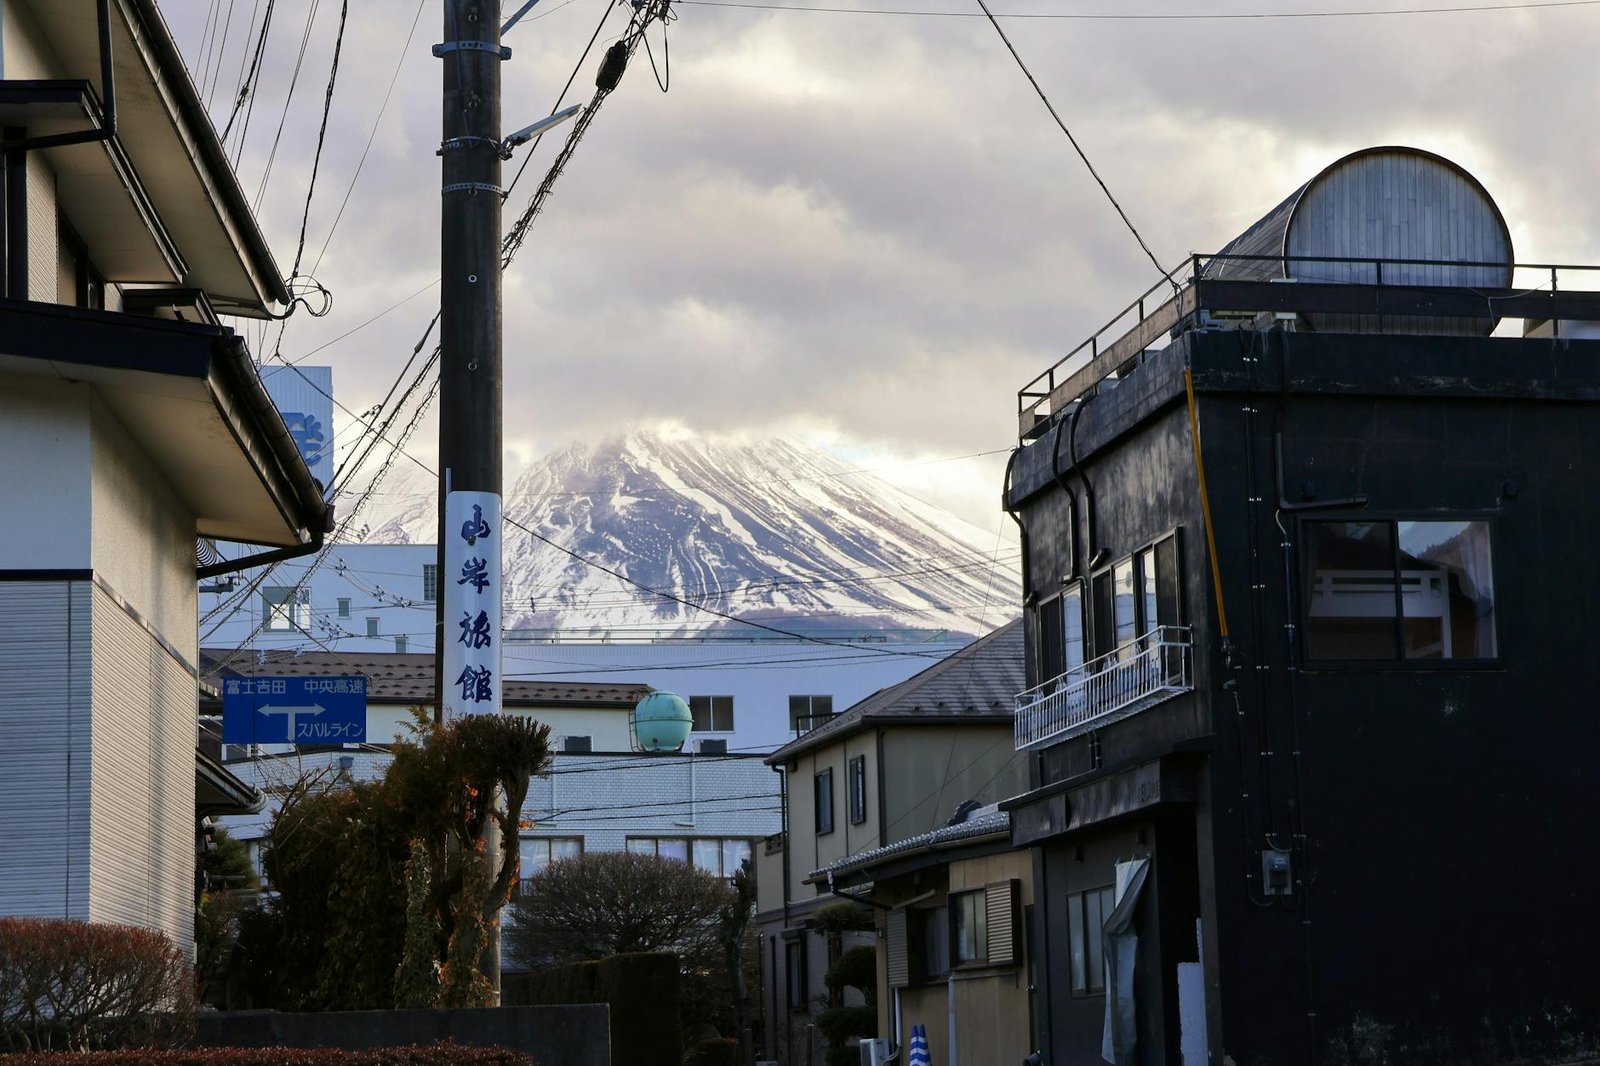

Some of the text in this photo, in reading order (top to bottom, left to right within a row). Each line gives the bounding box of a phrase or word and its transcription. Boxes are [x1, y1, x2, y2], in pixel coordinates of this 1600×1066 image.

[226, 679, 286, 694] 富士吉田
[304, 679, 364, 694] 中央高速
[297, 722, 363, 738] スバルライン
